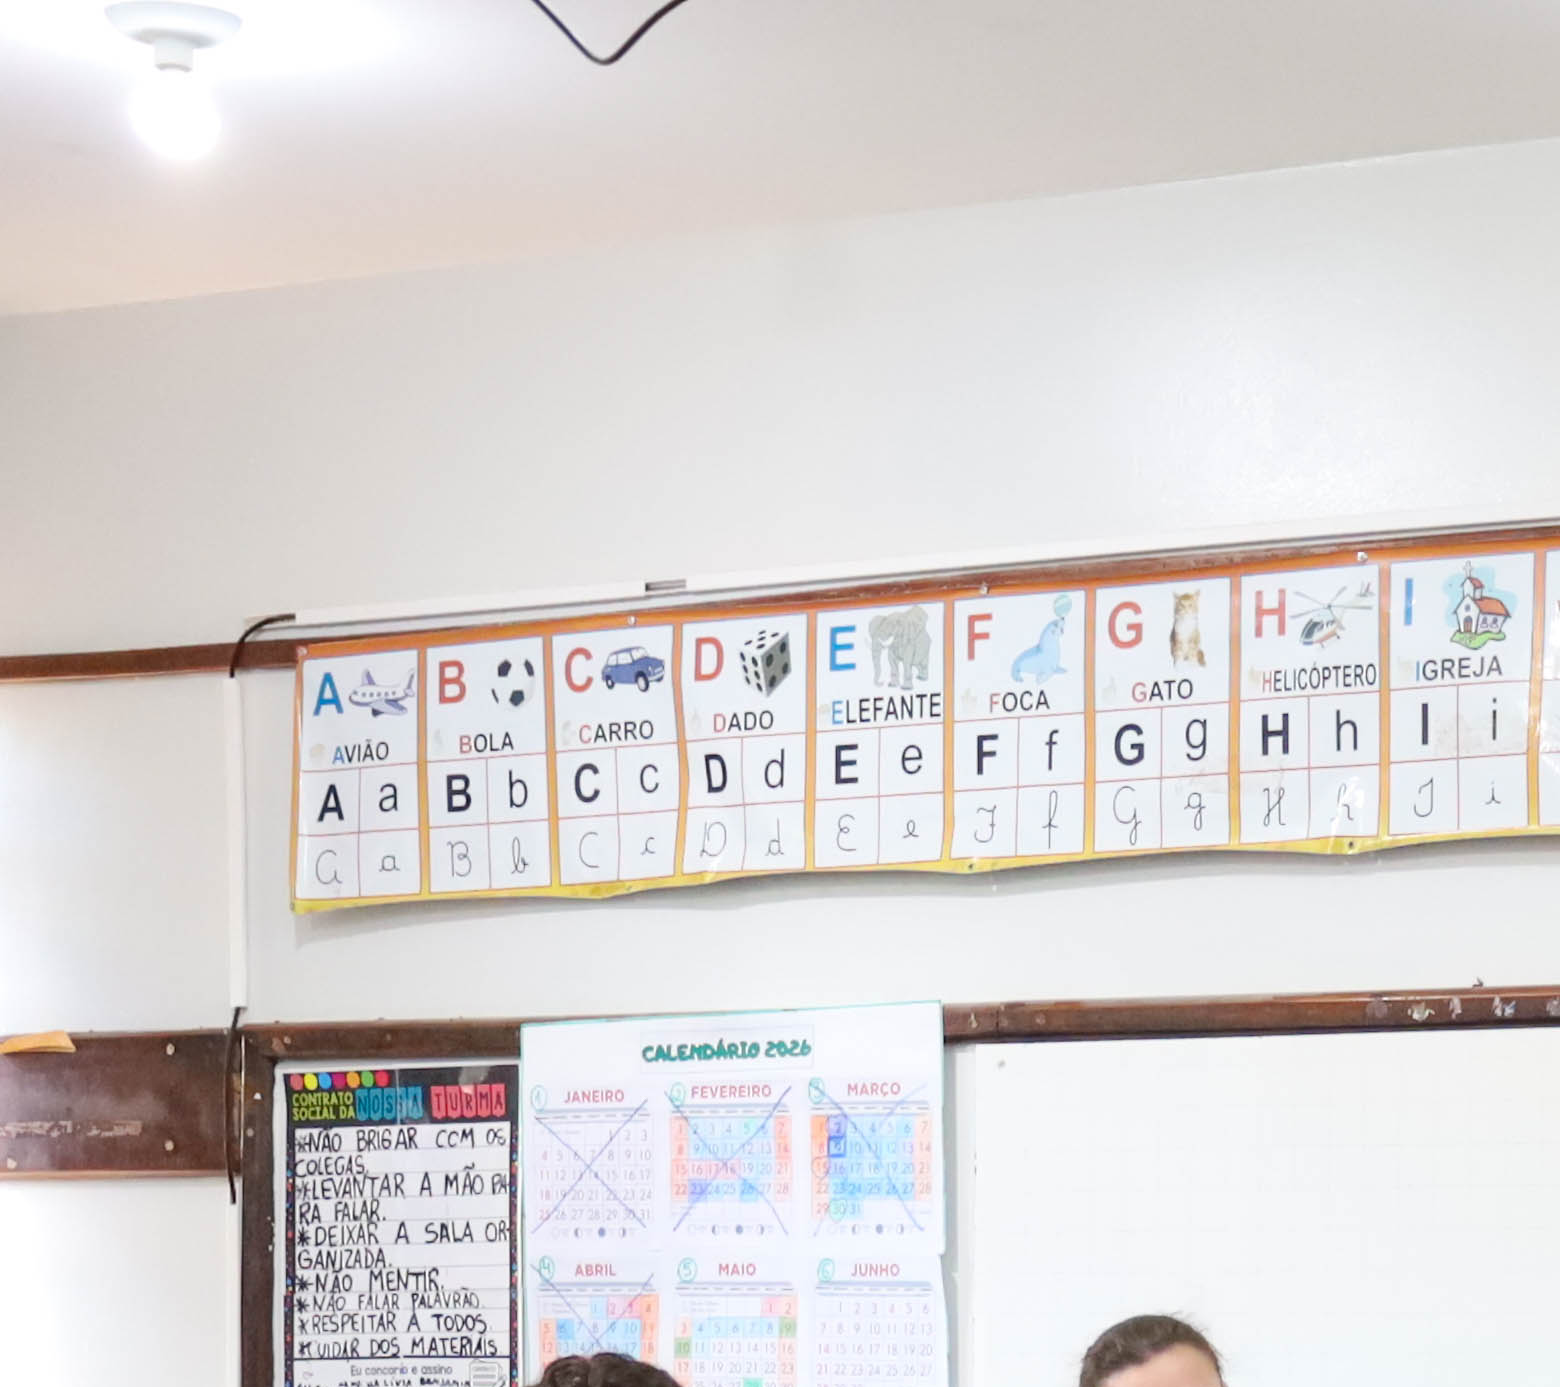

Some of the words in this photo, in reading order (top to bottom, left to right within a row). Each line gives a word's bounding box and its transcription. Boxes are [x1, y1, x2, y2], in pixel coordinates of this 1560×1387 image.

[1262, 662, 1377, 693] HELICÓPTERO
[1416, 657, 1502, 682] IGREJA
[988, 689, 1050, 713] FOCA
[1132, 679, 1193, 703] GATO
[713, 708, 774, 734] DADO
[831, 693, 942, 726] ELEFANTE
[460, 730, 514, 755] BOLA
[578, 719, 654, 745] CARRO
[332, 738, 389, 765] AVIÃO
[643, 1039, 759, 1063] CALENDÁRIO
[766, 1039, 811, 1058] 2026
[292, 1092, 353, 1107] CONTRATO
[564, 1089, 624, 1103] JANEIRO
[692, 1084, 772, 1099] FEVEREIRO
[847, 1082, 901, 1098] MARÇO
[292, 1106, 337, 1120] SOCIAL
[340, 1106, 356, 1118] DA
[357, 1090, 422, 1115] NOSSA
[433, 1091, 504, 1112] TURMA
[357, 1128, 418, 1152] BRIGAR
[313, 1172, 405, 1200] LEVANTAR
[420, 1172, 431, 1196] A
[445, 1162, 483, 1198] MÃO
[299, 1202, 321, 1226] RA
[315, 1223, 378, 1247] DEIXAR
[395, 1222, 409, 1244] A
[425, 1219, 473, 1243] SALA
[575, 1263, 616, 1277] ABRIL
[719, 1263, 756, 1276] MAIO
[851, 1263, 900, 1277] JUNHO
[358, 1293, 399, 1310] FALAR
[313, 1313, 396, 1334] RESPEITAR
[408, 1313, 420, 1332] A
[371, 1338, 400, 1356] DOS
